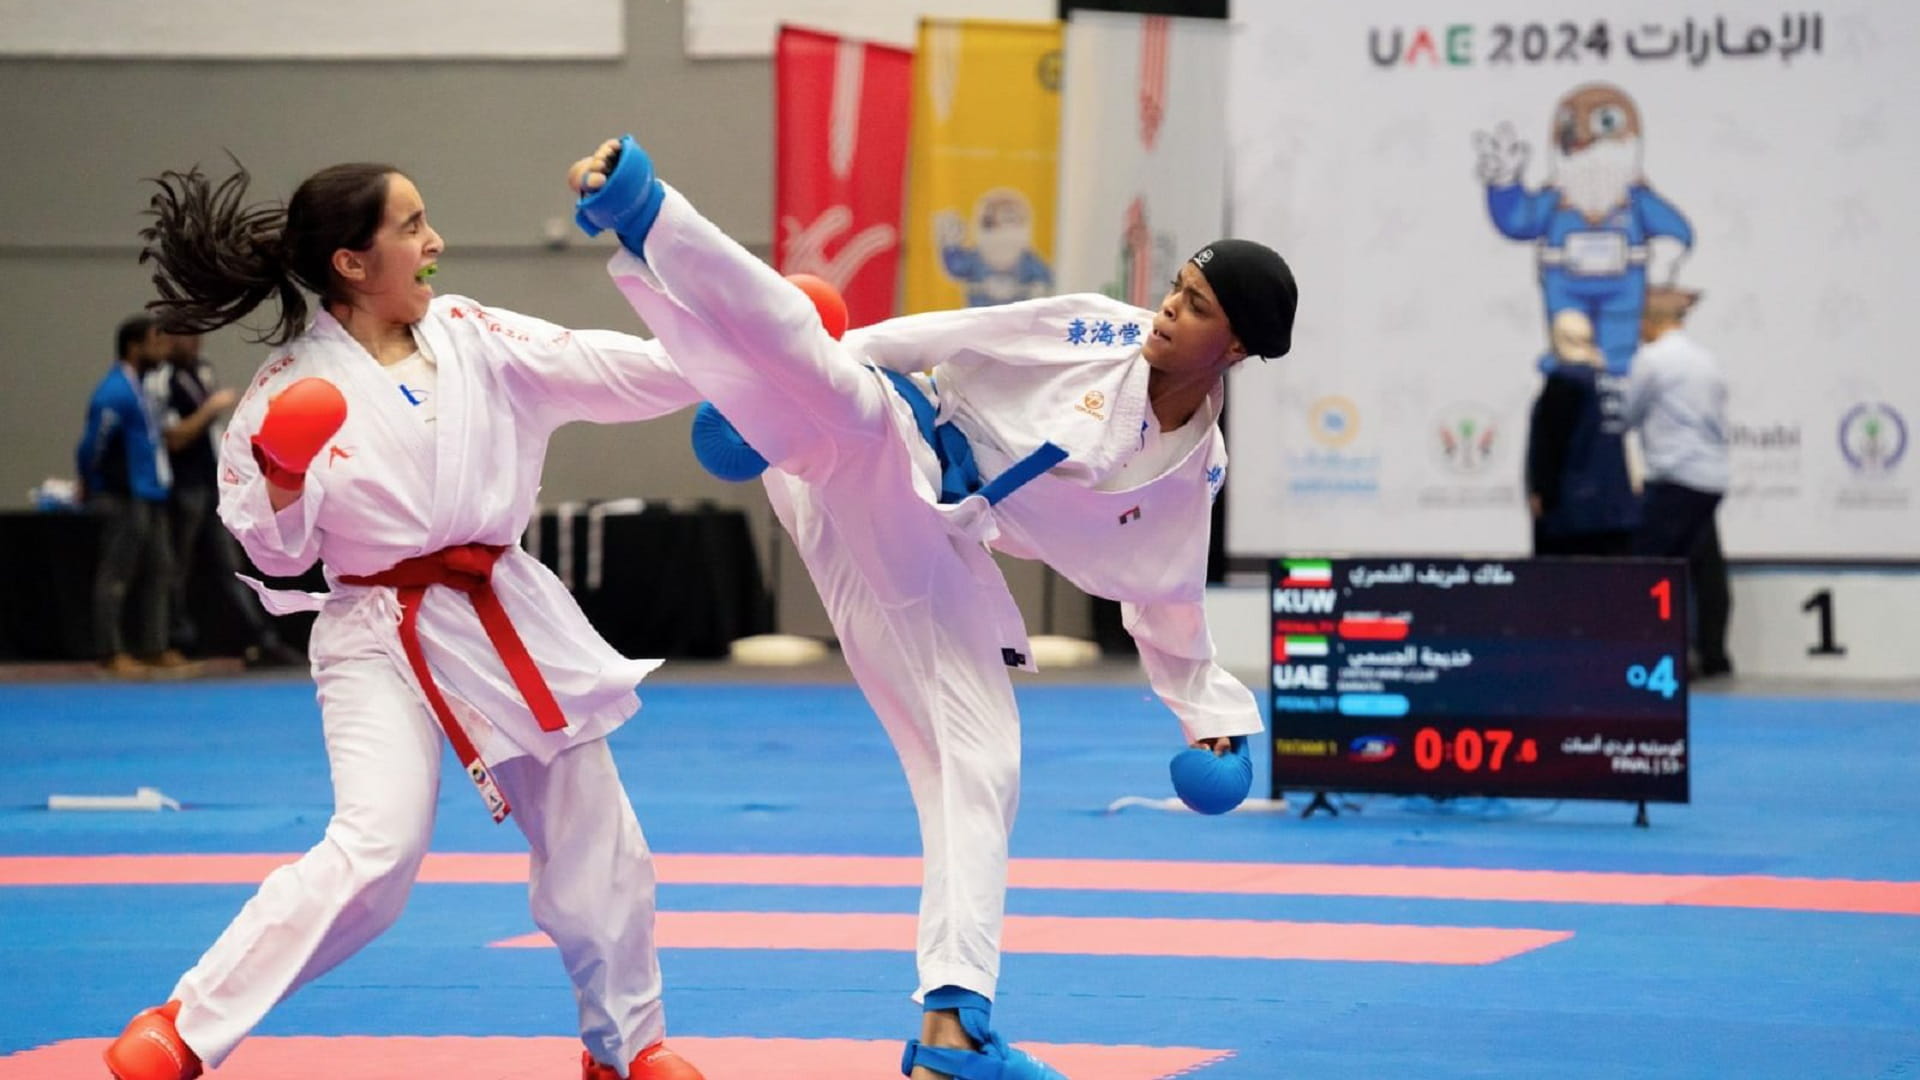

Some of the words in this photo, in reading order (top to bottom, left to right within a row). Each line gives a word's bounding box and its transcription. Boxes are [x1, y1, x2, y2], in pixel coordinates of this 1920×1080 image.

[1368, 24, 1474, 67] UAE
[1488, 18, 1611, 64] 2024
[1625, 12, 1824, 68] الإمارات
[1273, 588, 1337, 613] KUW
[1649, 578, 1671, 620] 1
[1802, 590, 1847, 656] 1
[1273, 664, 1329, 690] UAE
